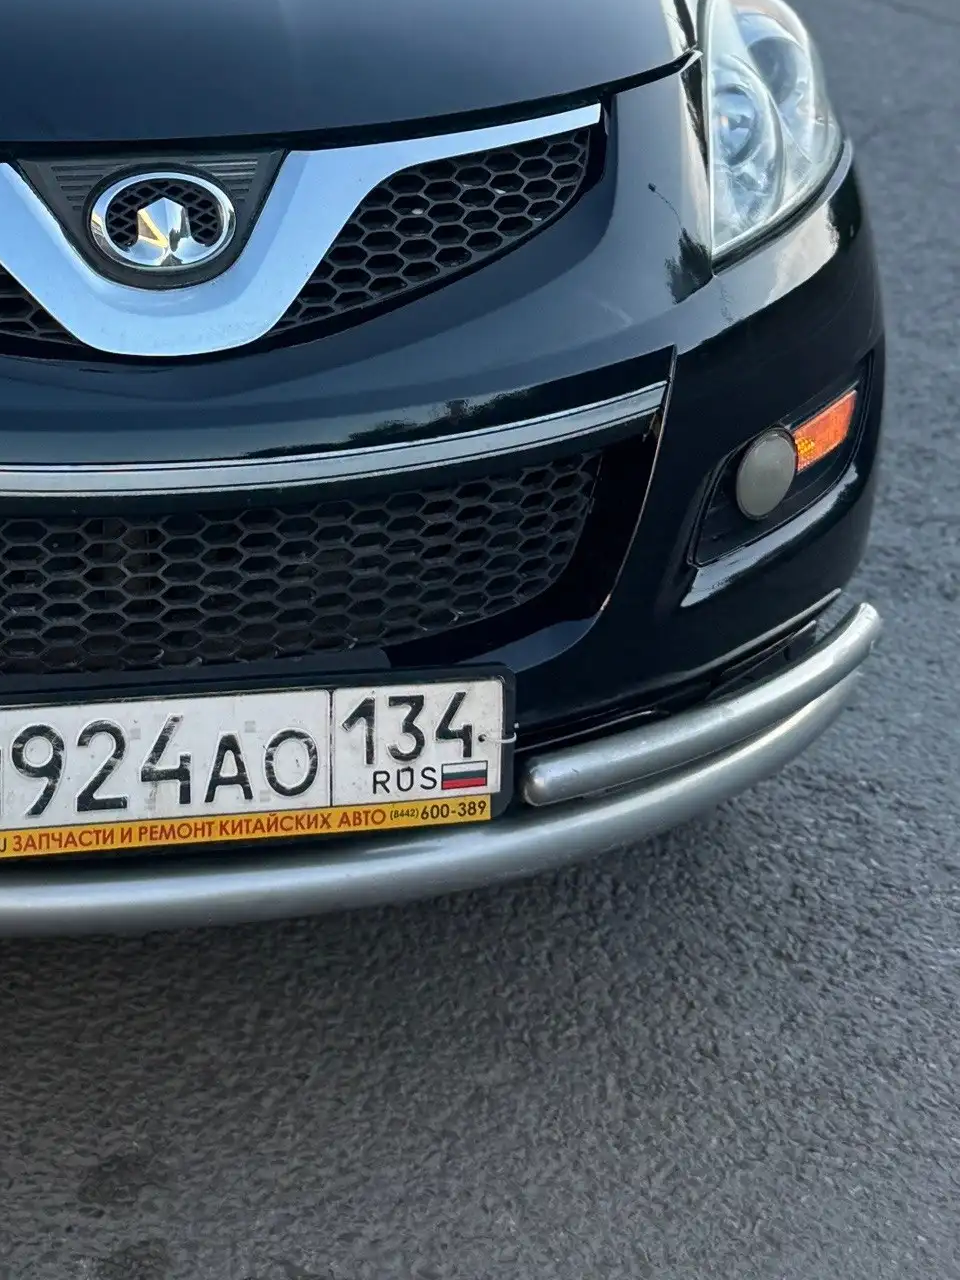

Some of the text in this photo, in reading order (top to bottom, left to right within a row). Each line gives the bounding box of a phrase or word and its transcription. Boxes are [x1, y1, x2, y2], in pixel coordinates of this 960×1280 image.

[342, 691, 473, 765] 134
[373, 766, 437, 794] RUS
[13, 827, 114, 852] ЗАПЧАСТИ
[120, 827, 133, 843] И
[139, 821, 215, 841] РЕМОНТ
[219, 812, 332, 836] КИТАЙСКИХ
[338, 809, 386, 828] АВТО
[390, 809, 419, 821] (8442)
[420, 800, 487, 820] 600-389
